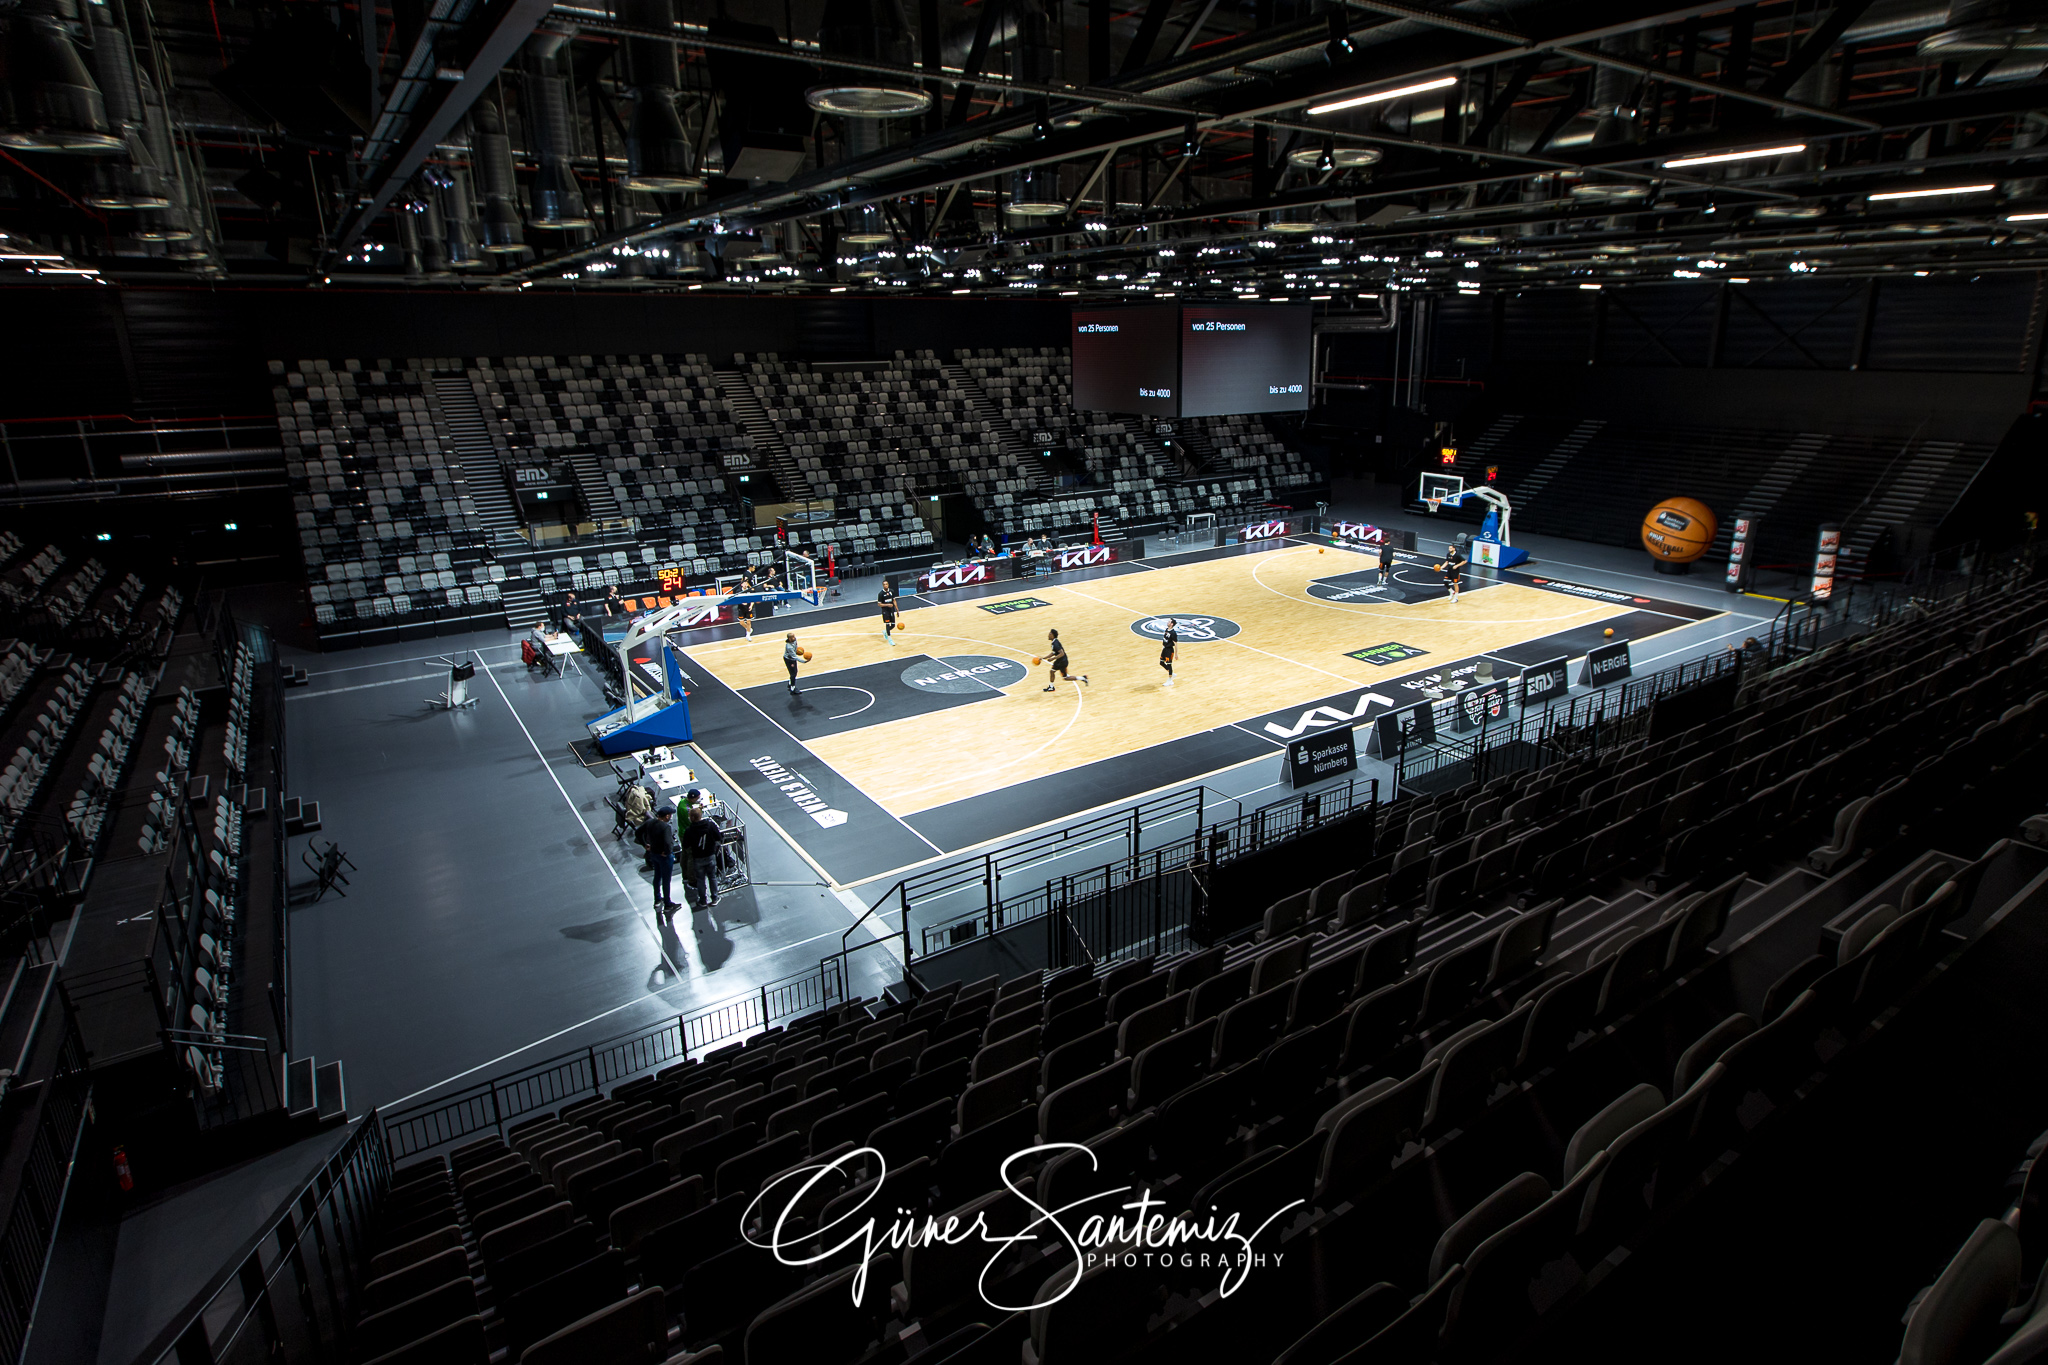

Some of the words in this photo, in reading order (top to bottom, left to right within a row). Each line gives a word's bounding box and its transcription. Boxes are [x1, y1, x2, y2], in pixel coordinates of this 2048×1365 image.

[1078, 325, 1087, 333] von
[1088, 324, 1094, 332] 25
[1096, 324, 1118, 332] Personen
[1192, 323, 1204, 331] von
[1206, 322, 1214, 331] 25
[1216, 322, 1246, 331] Personen
[1140, 388, 1148, 397] bis
[1157, 389, 1170, 398] 4000
[1269, 385, 1278, 394] bis
[1288, 384, 1302, 393] 4000
[723, 454, 751, 466] EMS
[1443, 455, 1454, 463] 24
[515, 468, 549, 482] EMS
[1245, 521, 1285, 540] KIA
[1339, 520, 1383, 542] KIA
[1061, 547, 1109, 568] KIA
[658, 567, 684, 579] 50:21
[928, 565, 985, 589] KIA
[664, 577, 682, 591] 24
[984, 598, 1036, 609] BARMER
[1352, 644, 1403, 658] BARMER
[1527, 672, 1554, 696] EMS
[1264, 692, 1394, 738] KIA
[1312, 742, 1348, 761] Sparkasse
[1314, 757, 1348, 774] Nürnberg
